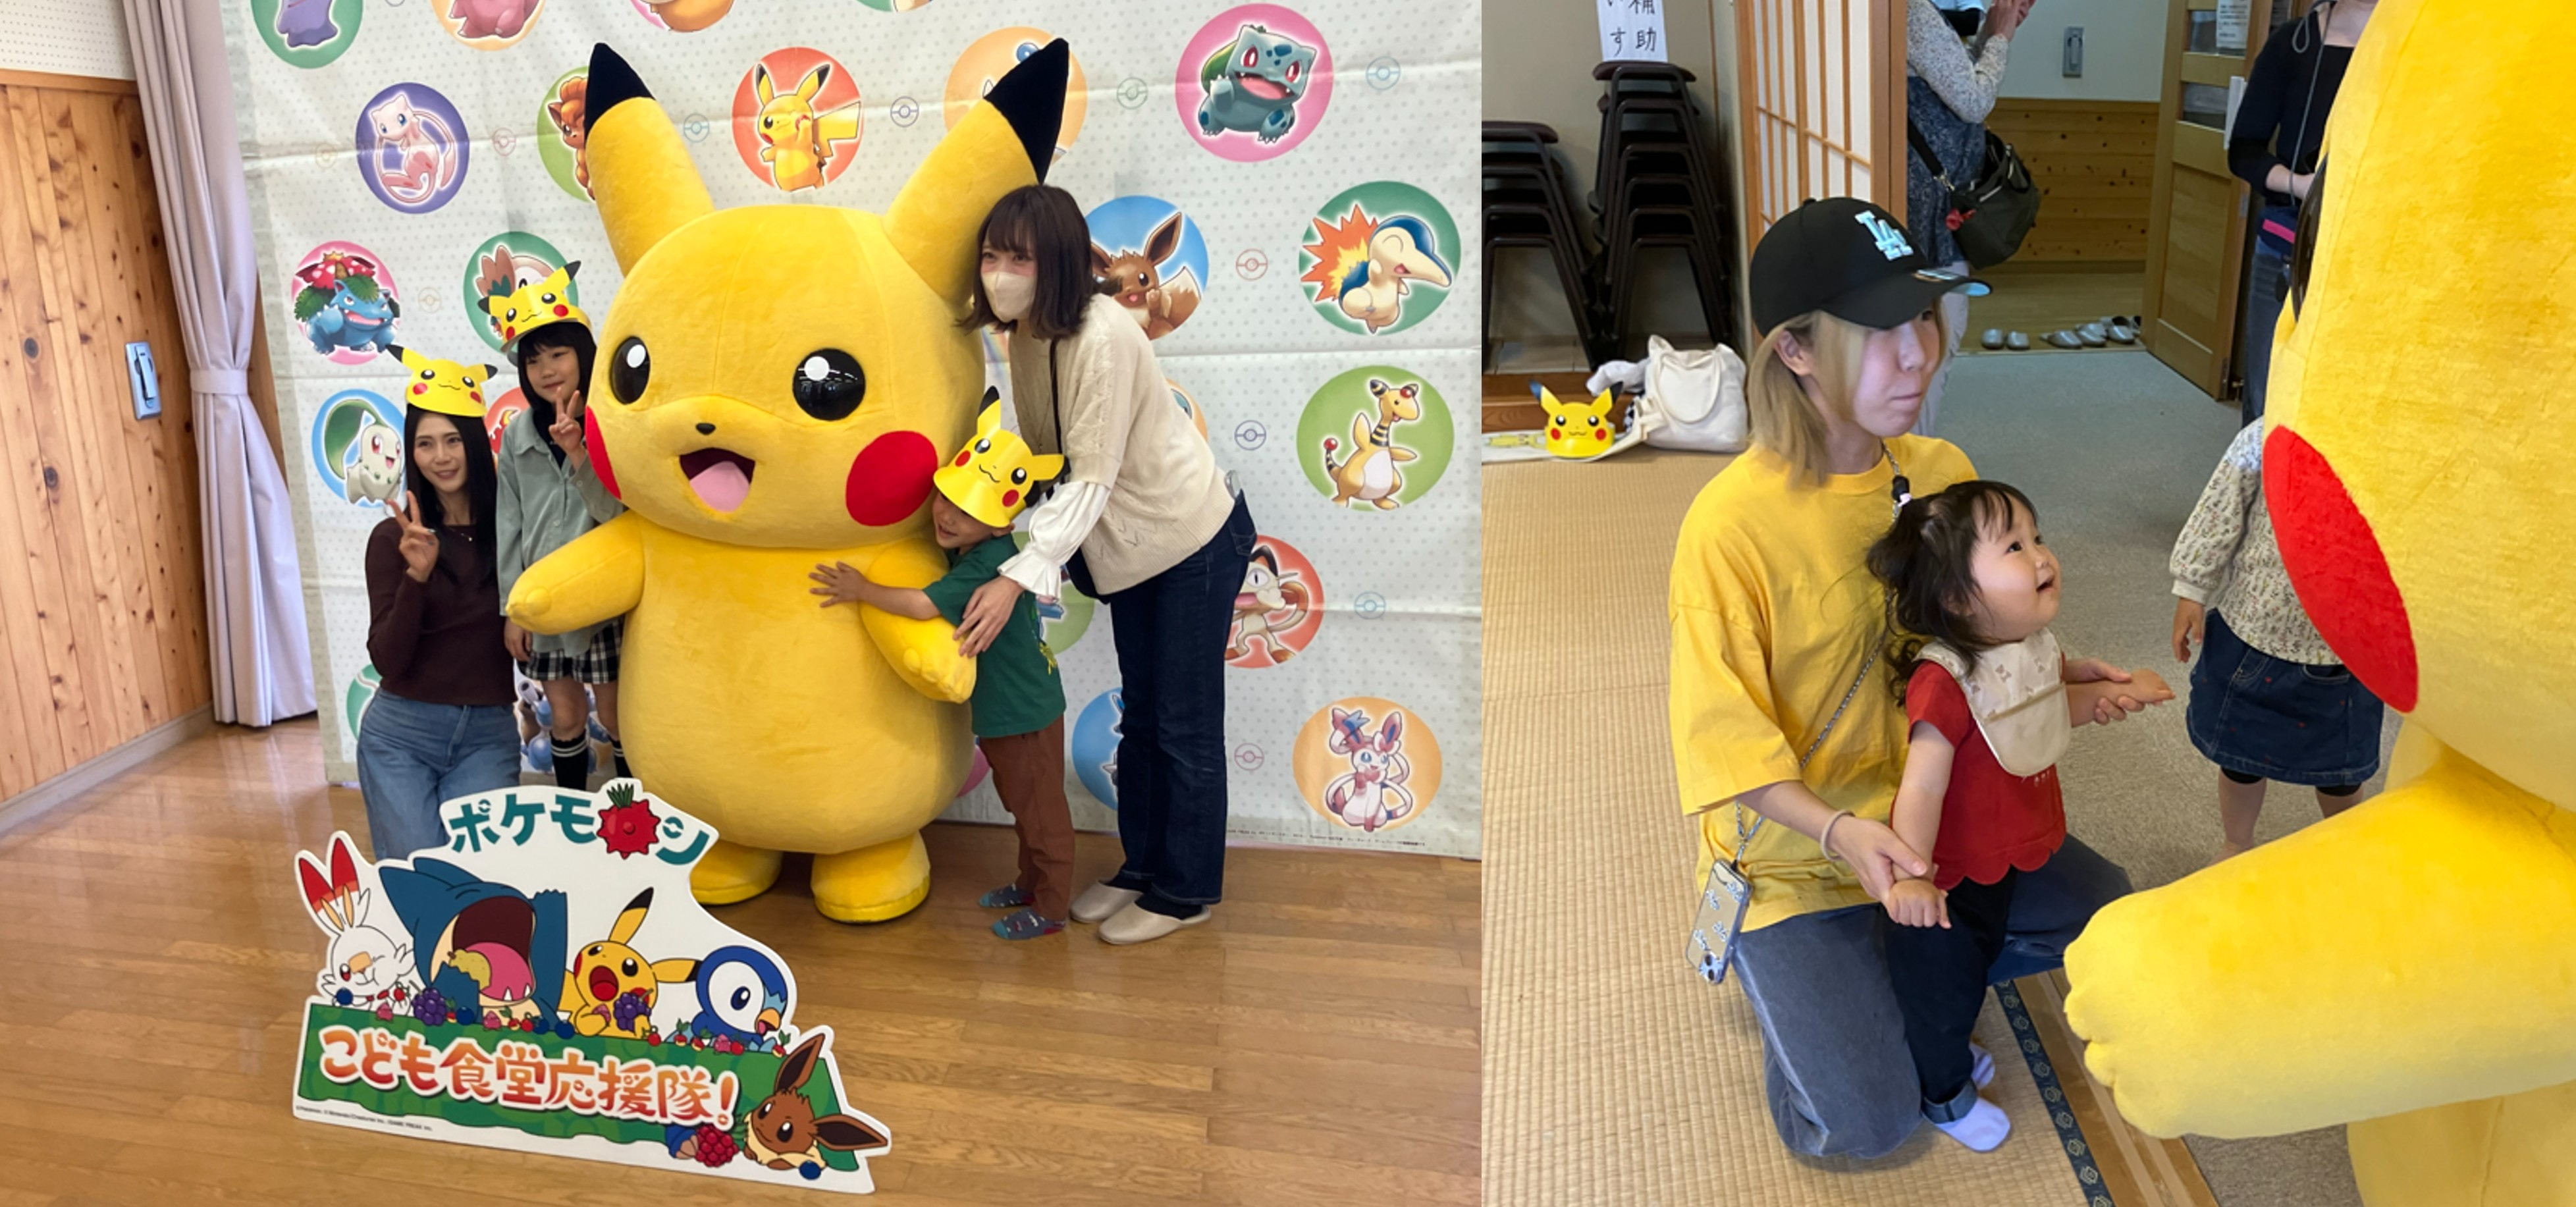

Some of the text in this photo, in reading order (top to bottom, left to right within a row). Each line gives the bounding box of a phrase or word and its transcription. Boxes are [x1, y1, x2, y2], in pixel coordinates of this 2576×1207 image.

[1854, 210, 1914, 261] LA
[449, 793, 710, 865] ポケモン
[323, 1029, 736, 1126] こども食堂応援隊!
